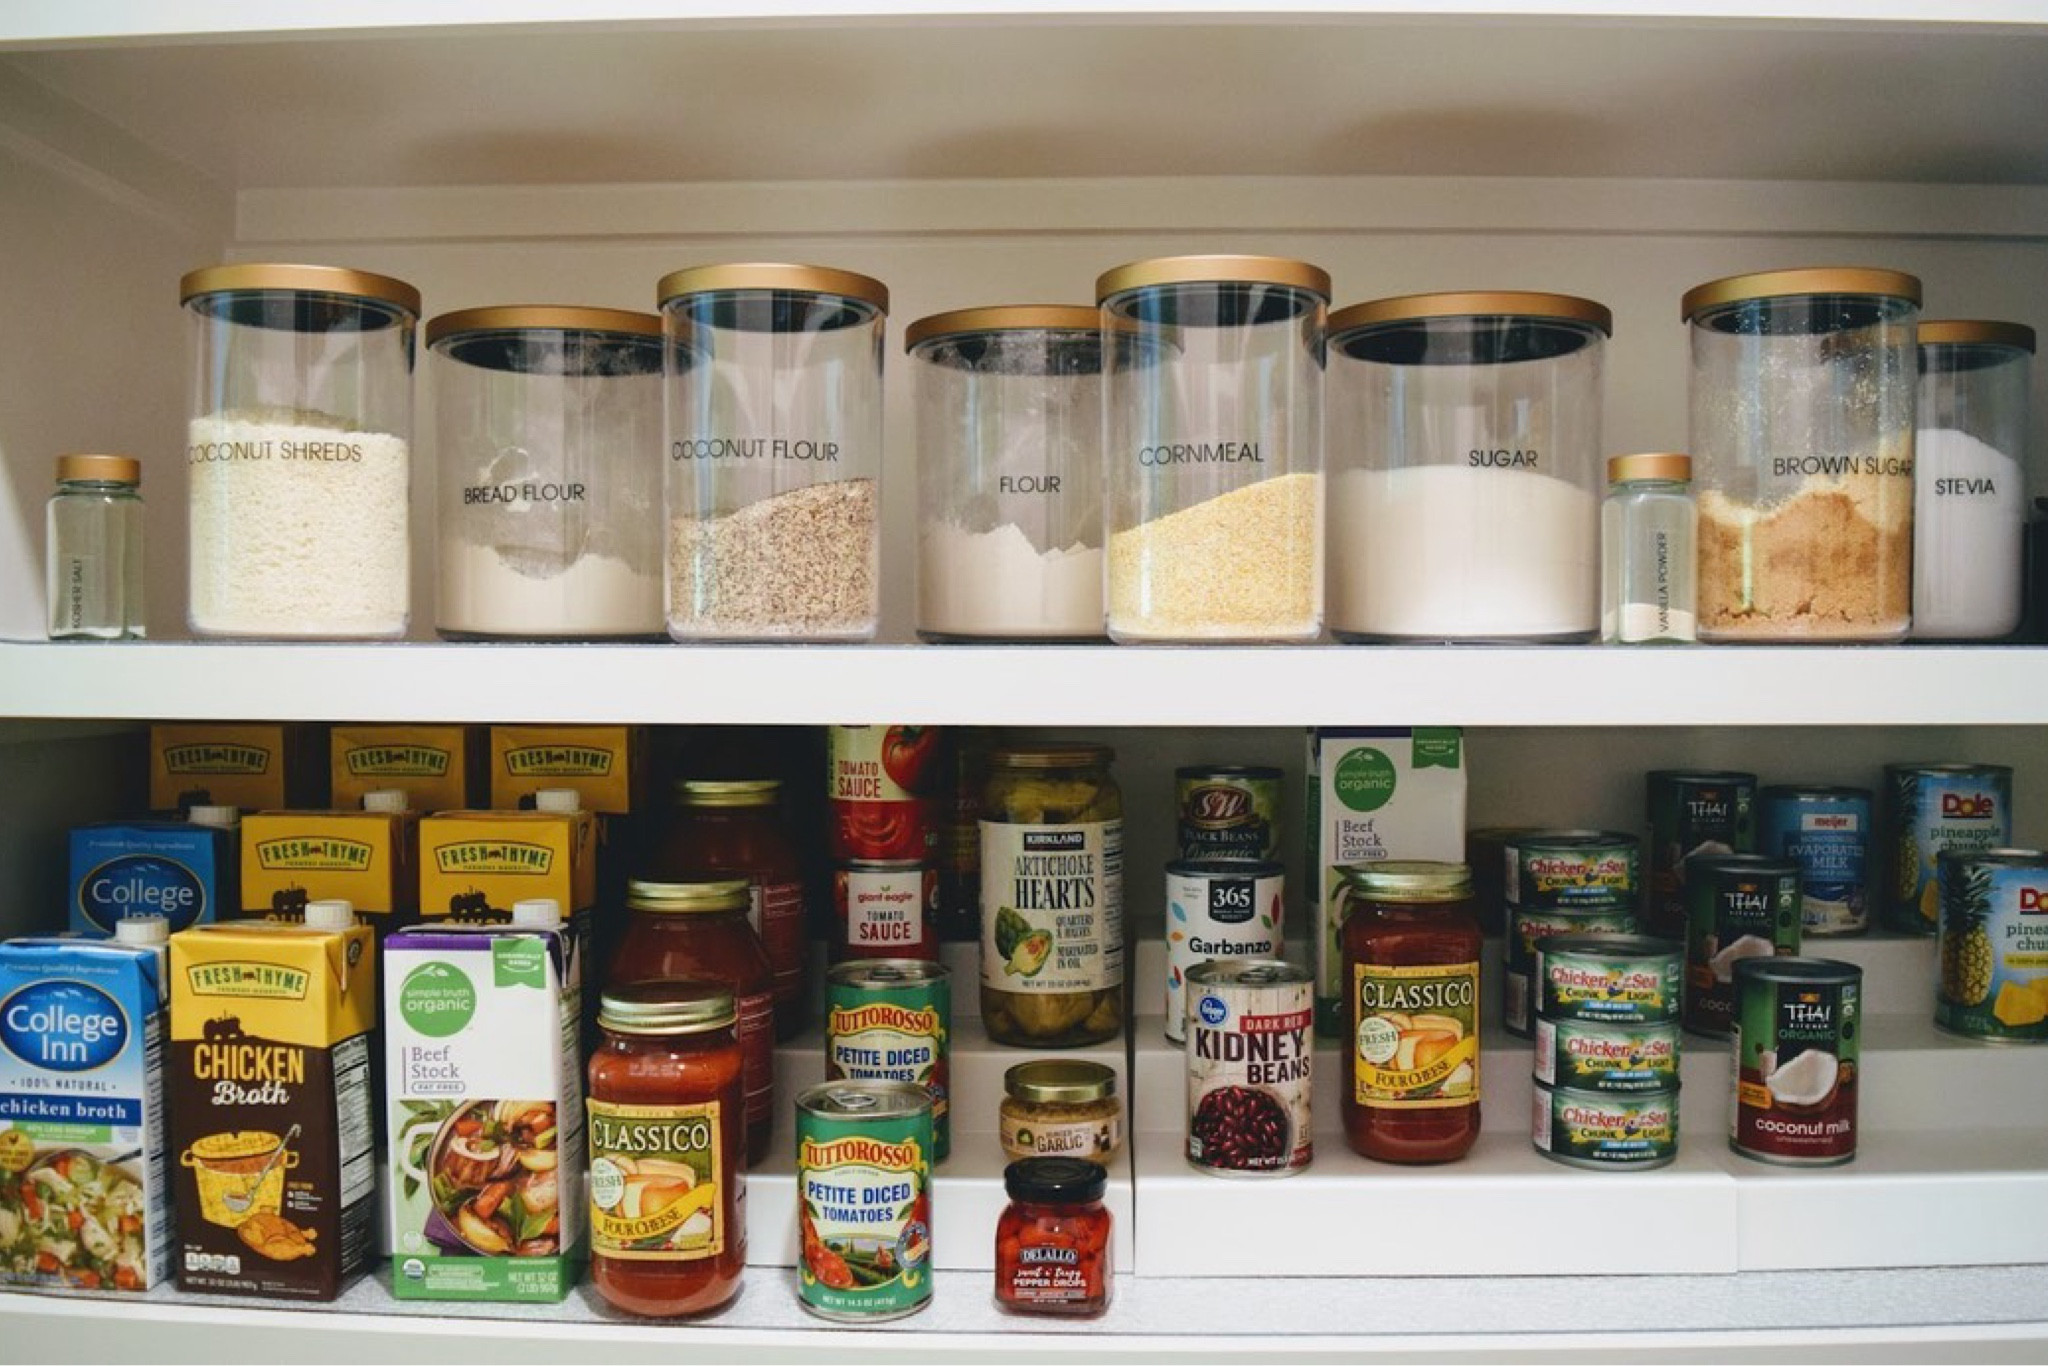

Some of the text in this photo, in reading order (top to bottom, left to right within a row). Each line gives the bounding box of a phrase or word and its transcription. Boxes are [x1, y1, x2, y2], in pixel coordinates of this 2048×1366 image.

[189, 440, 362, 464] COCONUT SHREDS
[672, 438, 839, 462] COCONUT FLOUR
[1139, 442, 1264, 466] CORNMEAL
[1469, 449, 1538, 468] SUGAR
[1773, 455, 1913, 477] BROWN SUGAR
[464, 483, 585, 504] BREAD FLOUR
[1000, 476, 1061, 493] FLOUR
[1935, 478, 1995, 496] STEVIA
[1658, 532, 1668, 633] VANILLA POWDER
[72, 559, 84, 630] KOSHER SALT
[169, 746, 267, 768] FRESH THYME
[350, 748, 447, 770] FRESH THYME
[508, 748, 609, 770] FRESH THYME
[837, 760, 879, 776] TOMATO
[837, 778, 881, 798] SAUCE
[1340, 778, 1392, 791] organic
[1687, 801, 1728, 817] THAI
[1942, 793, 1995, 814] Dole
[1343, 818, 1374, 833] Beef
[1814, 815, 1848, 829] meijer
[1025, 833, 1083, 843] KIRKLAND
[1343, 834, 1383, 848] Stock
[1930, 826, 2000, 841] pineapple
[263, 838, 369, 864] FRESH THYME
[441, 841, 549, 868] FRESH THYME
[1014, 854, 1094, 876] ARTICHOKE
[1530, 859, 1626, 876] Chicken Sea
[1811, 856, 1849, 869] MILK
[1546, 875, 1624, 886] CHUNK LIGHT
[92, 878, 194, 912] College
[857, 891, 914, 904] giant eagle
[1014, 877, 1095, 910] HEARTS
[1213, 886, 1251, 908] 365
[1723, 892, 1768, 910] THAI
[867, 910, 905, 922] TOMATO
[859, 922, 912, 941] SAUCE
[1188, 936, 1272, 955] Garbanzo
[194, 965, 304, 993] FRESH THYME
[1551, 967, 1658, 989] Chicken Sea
[1362, 981, 1473, 1009] CLASSICO
[1565, 987, 1656, 1000] CHUNK LIGHT
[406, 998, 470, 1014] organic
[1783, 1003, 1832, 1022] THAI
[7, 1004, 118, 1042] College
[835, 1007, 933, 1032] TUTTOROSSO
[1245, 1014, 1304, 1031] DARK RED
[1195, 1027, 1304, 1062] KIDNEY
[1778, 1029, 1836, 1041] ORGANIC
[41, 1034, 87, 1062] Inn
[412, 1045, 451, 1061] Beef
[836, 1045, 930, 1066] PETITE DICED
[1567, 1039, 1672, 1058] Chicken Sea
[194, 1044, 305, 1084] CHICKEN
[412, 1062, 460, 1078] Stock
[1247, 1055, 1310, 1084] BEANS
[1585, 1057, 1669, 1068] CHUNK LIGHT
[849, 1068, 915, 1081] TOMATOES
[1375, 1061, 1452, 1087] FOUR CHEESE
[20, 1078, 107, 1092] 100% NATURAL
[211, 1080, 290, 1105] Broth
[0, 1098, 127, 1120] chicken broth
[1563, 1107, 1668, 1127] Chicken Sea
[592, 1119, 709, 1151] CLASSICO
[1580, 1127, 1665, 1138] CHUNK LIGHT
[1755, 1119, 1850, 1135] coconut milk
[804, 1141, 914, 1166] TUTTOROSSO
[1037, 1135, 1084, 1153] GARLIC
[807, 1180, 911, 1205] PETITE DICED
[603, 1206, 684, 1235] FOUR CHEESE
[822, 1206, 894, 1223] TOMATOES
[1022, 1249, 1076, 1262] DELALLO
[1013, 1277, 1086, 1287] PEPPER DROPS
